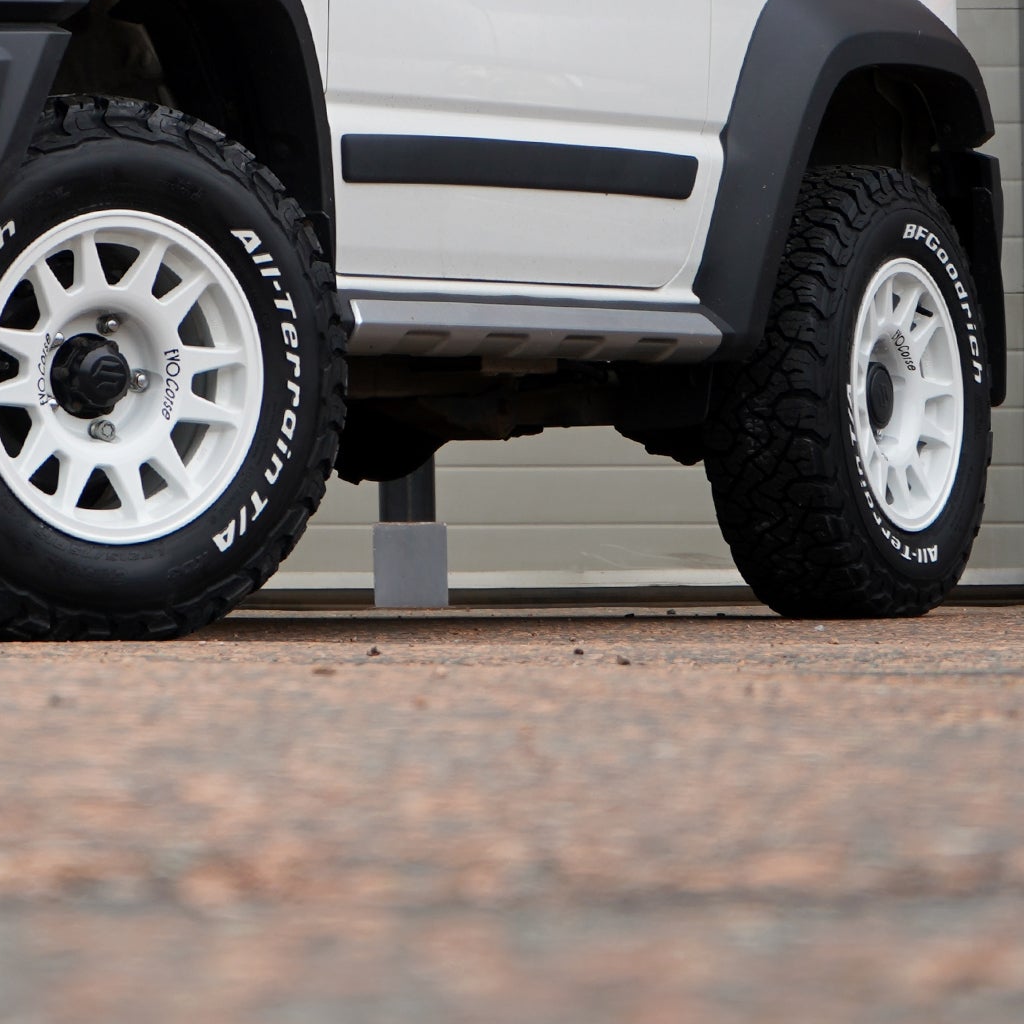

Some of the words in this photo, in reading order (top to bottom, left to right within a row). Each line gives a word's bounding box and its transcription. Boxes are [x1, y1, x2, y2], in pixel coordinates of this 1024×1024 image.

[230, 228, 302, 486] All-Terrain
[902, 222, 984, 385] BFGoodrich
[211, 490, 270, 553] T/A
